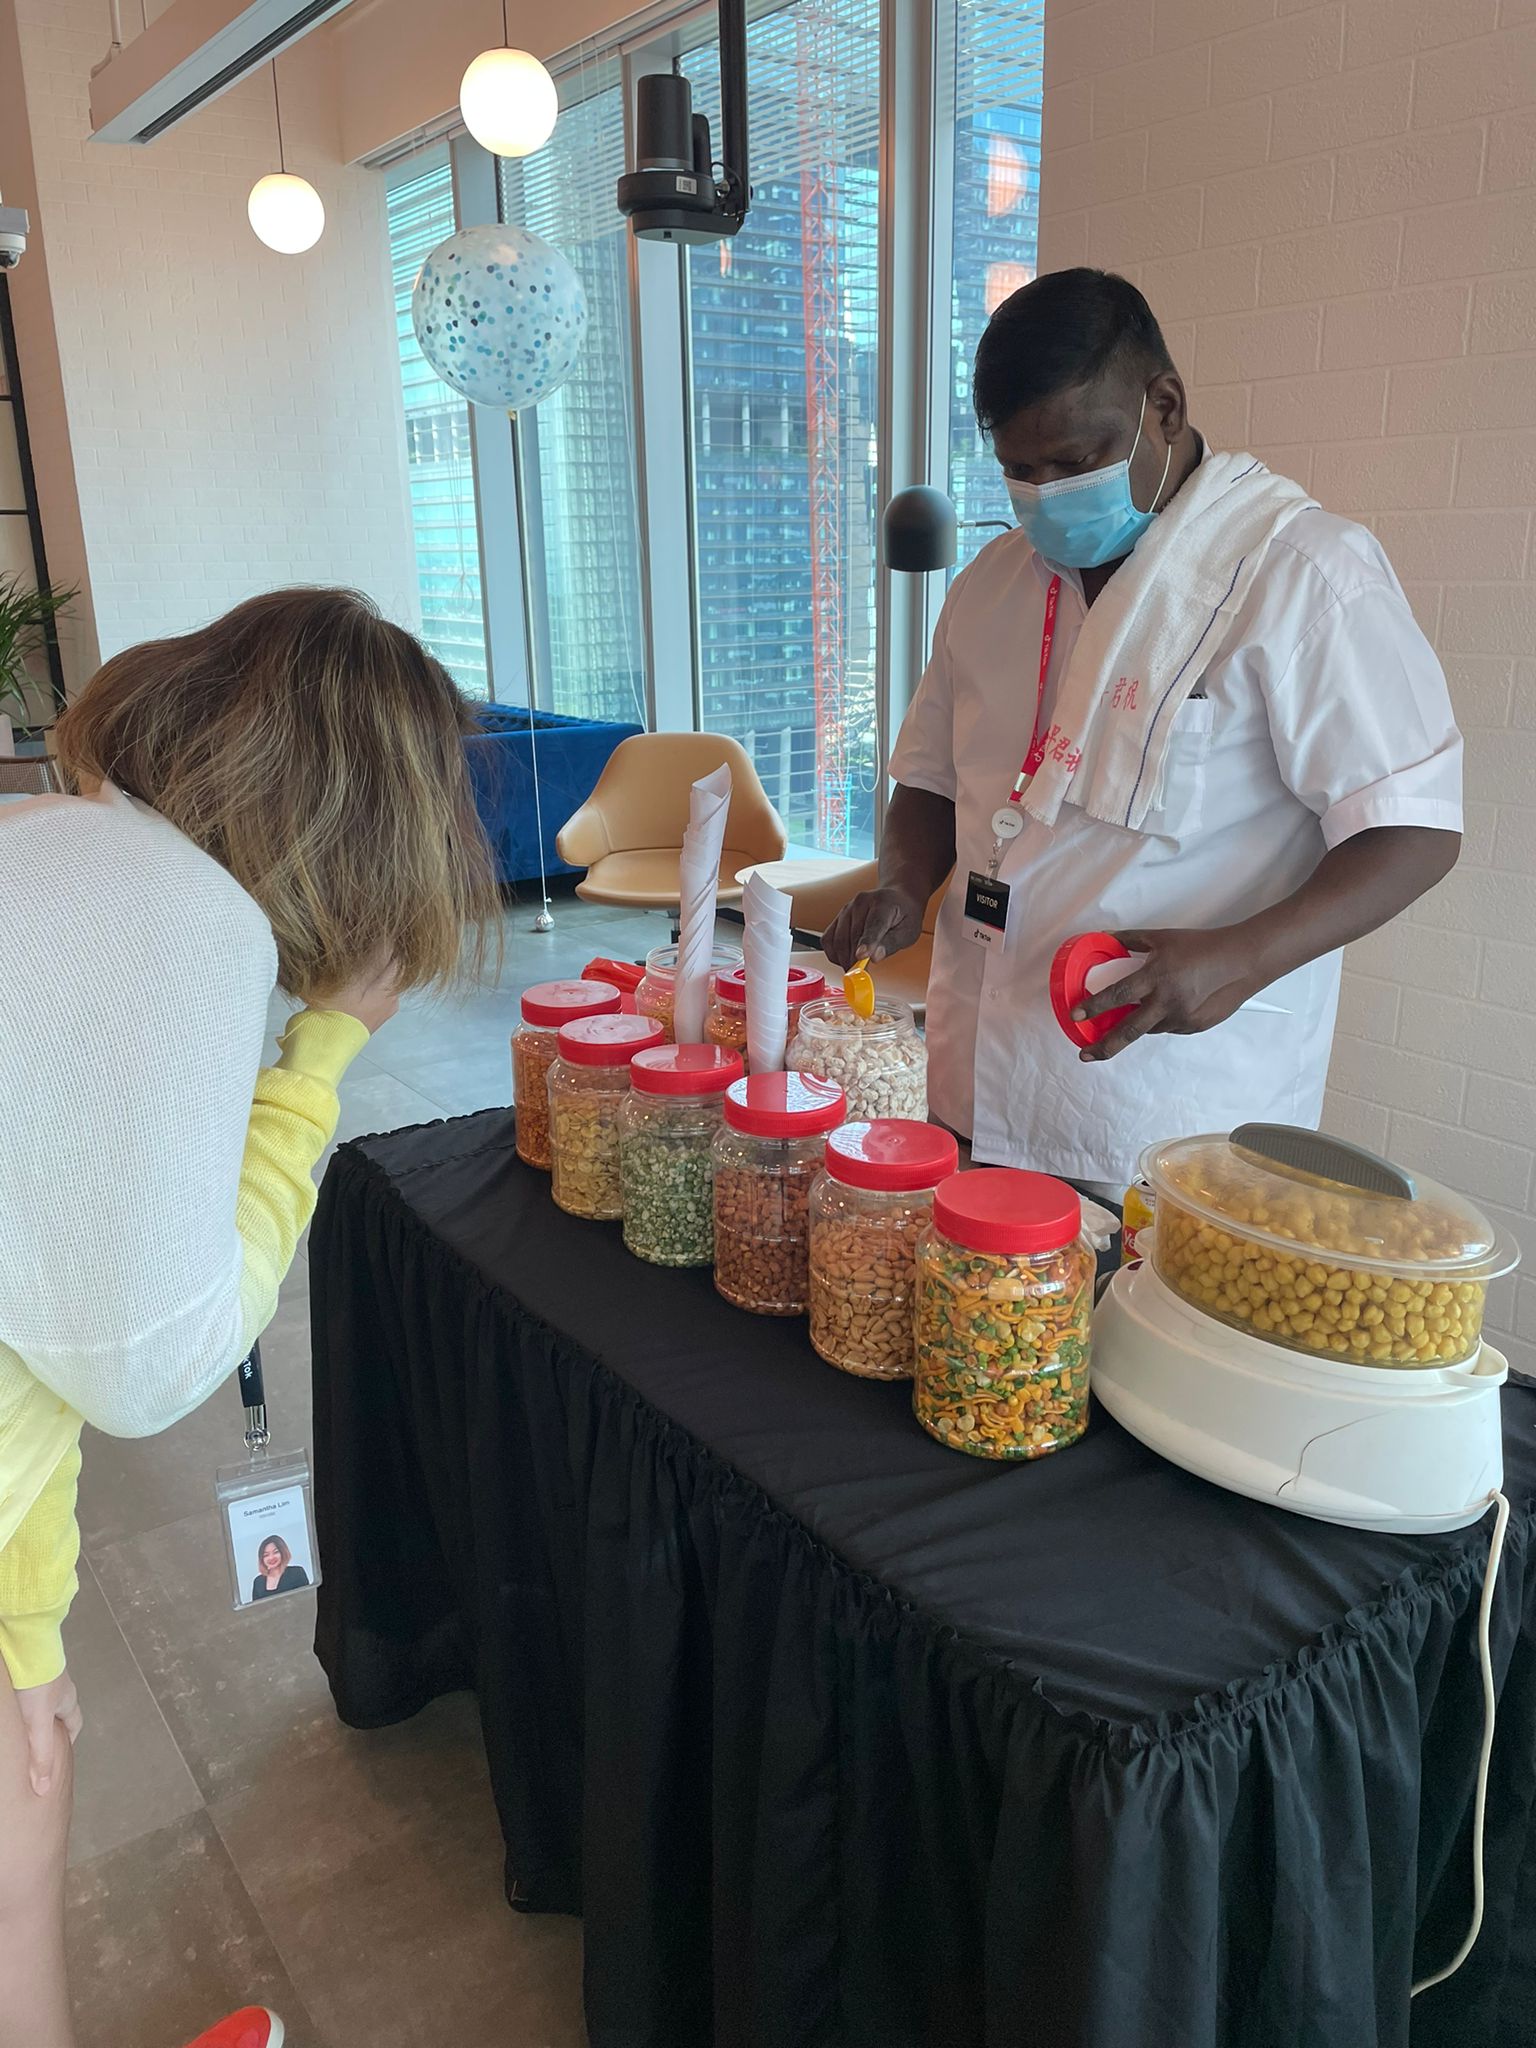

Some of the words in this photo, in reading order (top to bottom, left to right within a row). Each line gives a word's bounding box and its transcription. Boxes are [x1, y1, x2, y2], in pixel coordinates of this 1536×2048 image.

[976, 893, 999, 910] VISITOR
[1124, 1229, 1136, 1247] Ye
[243, 1503, 277, 1517] Samantha
[277, 1500, 290, 1508] Lim
